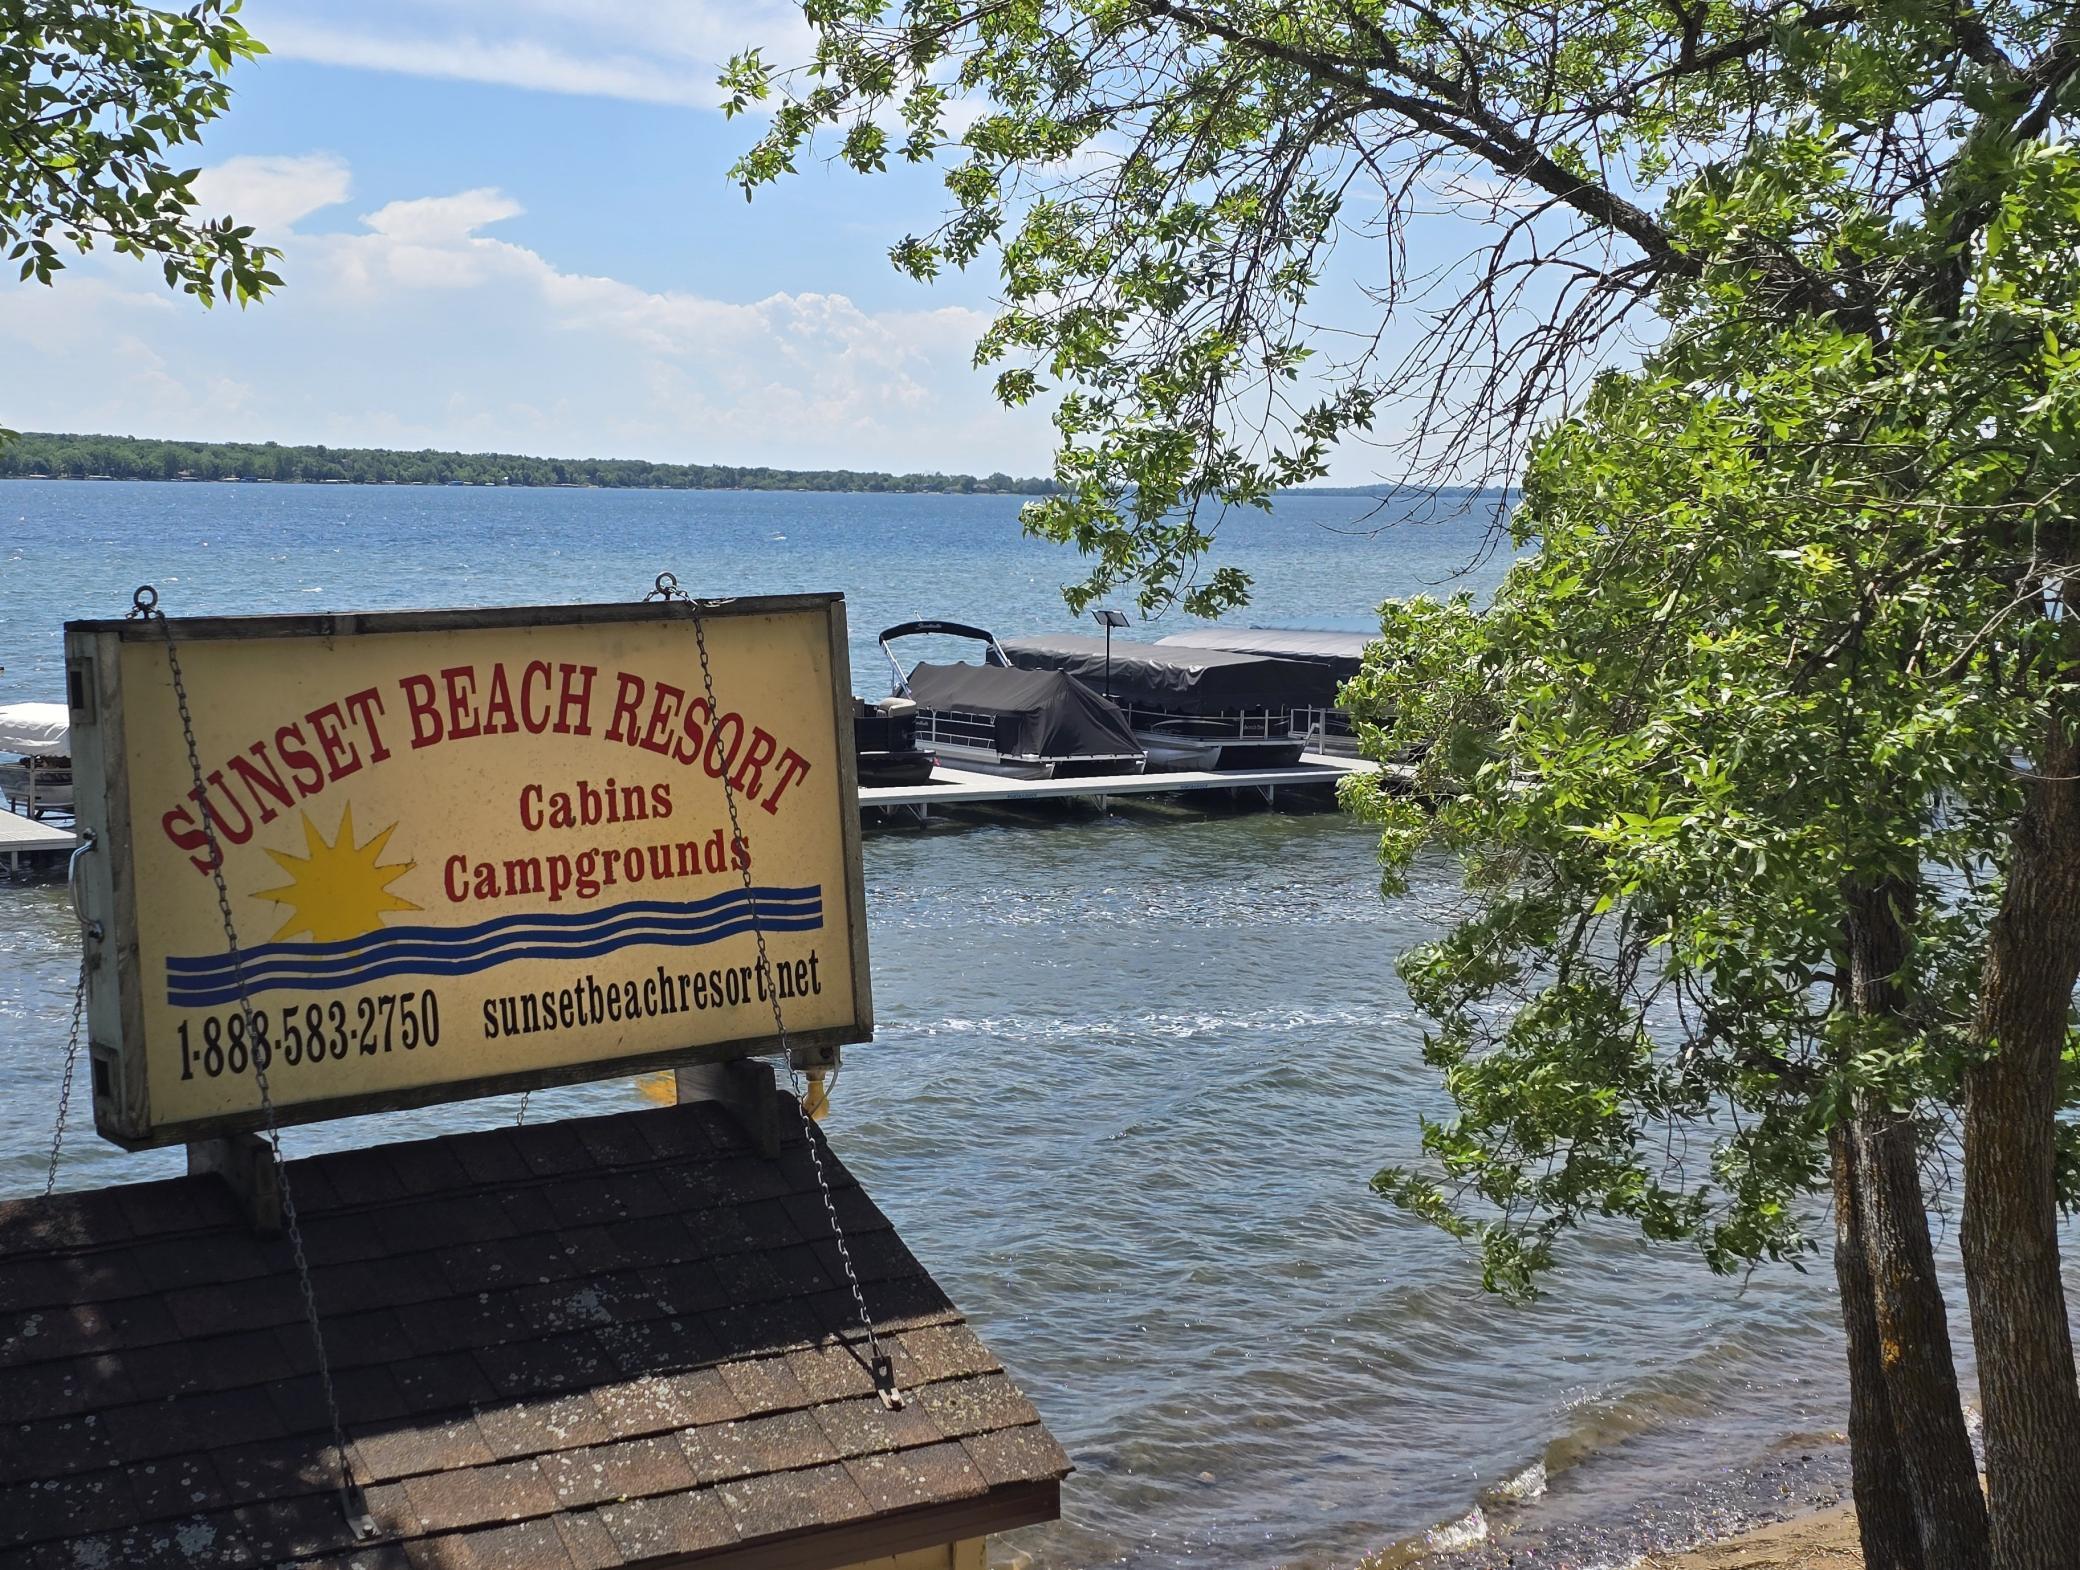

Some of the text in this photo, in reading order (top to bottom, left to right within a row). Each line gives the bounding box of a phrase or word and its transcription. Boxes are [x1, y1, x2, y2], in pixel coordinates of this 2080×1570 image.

[161, 660, 812, 877] SUNSET BEACH RESORT
[519, 777, 673, 832] Cabins
[443, 828, 752, 903] Campgrounds
[483, 948, 822, 1040] sunsetbeachresortnet
